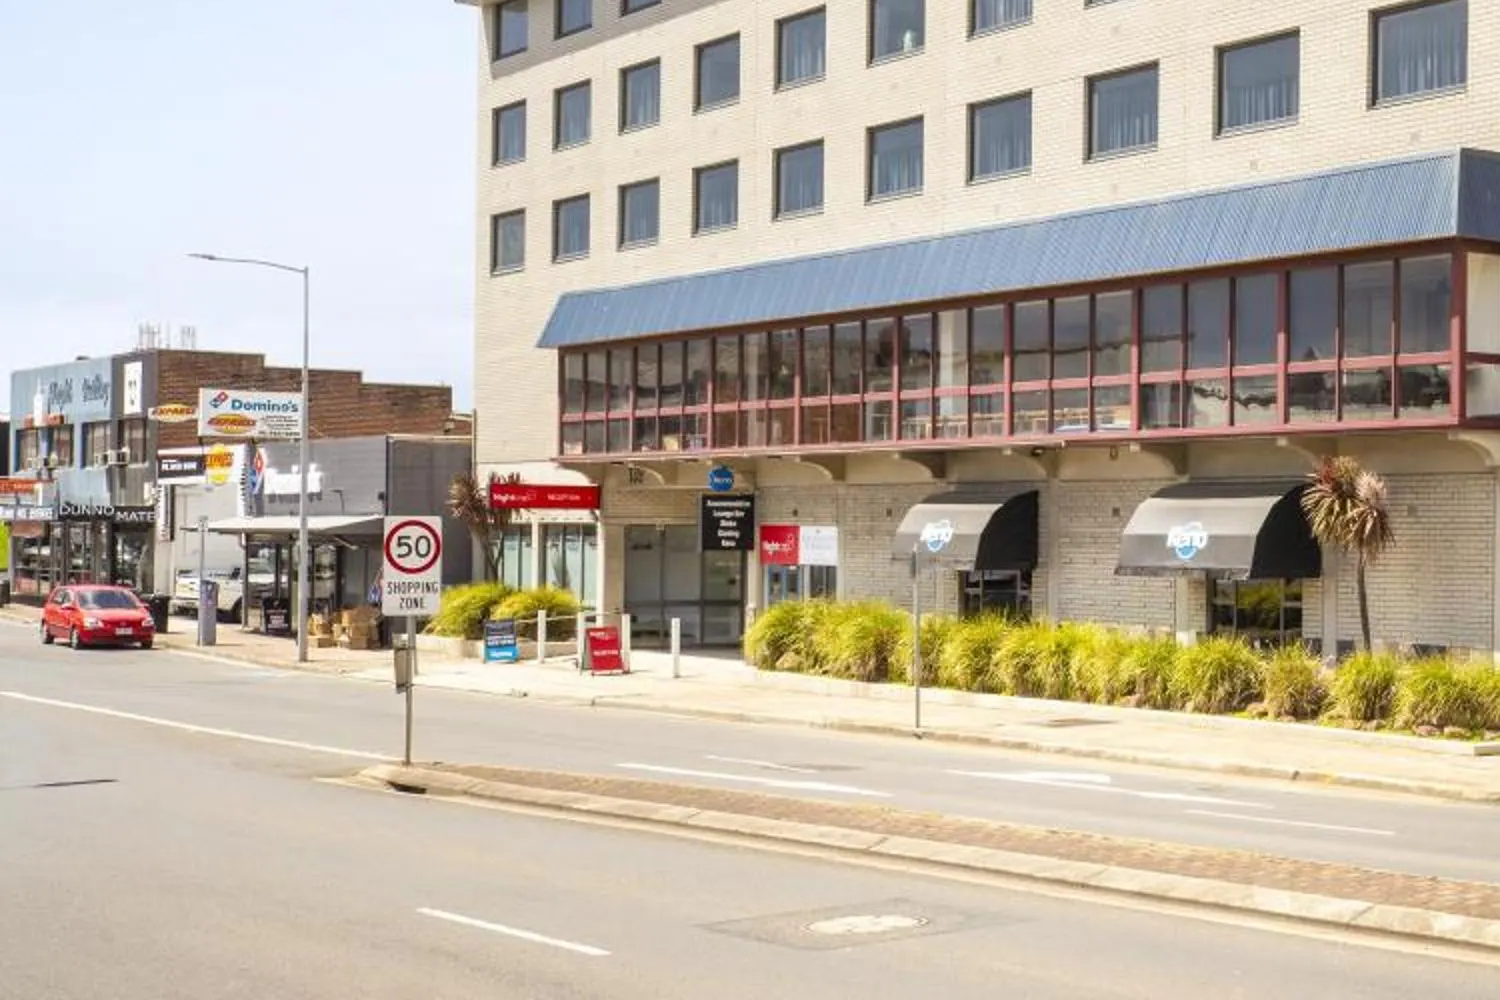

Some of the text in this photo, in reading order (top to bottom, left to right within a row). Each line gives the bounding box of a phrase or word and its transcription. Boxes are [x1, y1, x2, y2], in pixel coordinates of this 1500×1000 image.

[231, 399, 299, 413] Domino's
[396, 535, 432, 559] 50
[387, 581, 439, 596] SHOPPING
[399, 597, 426, 609] ZONE
